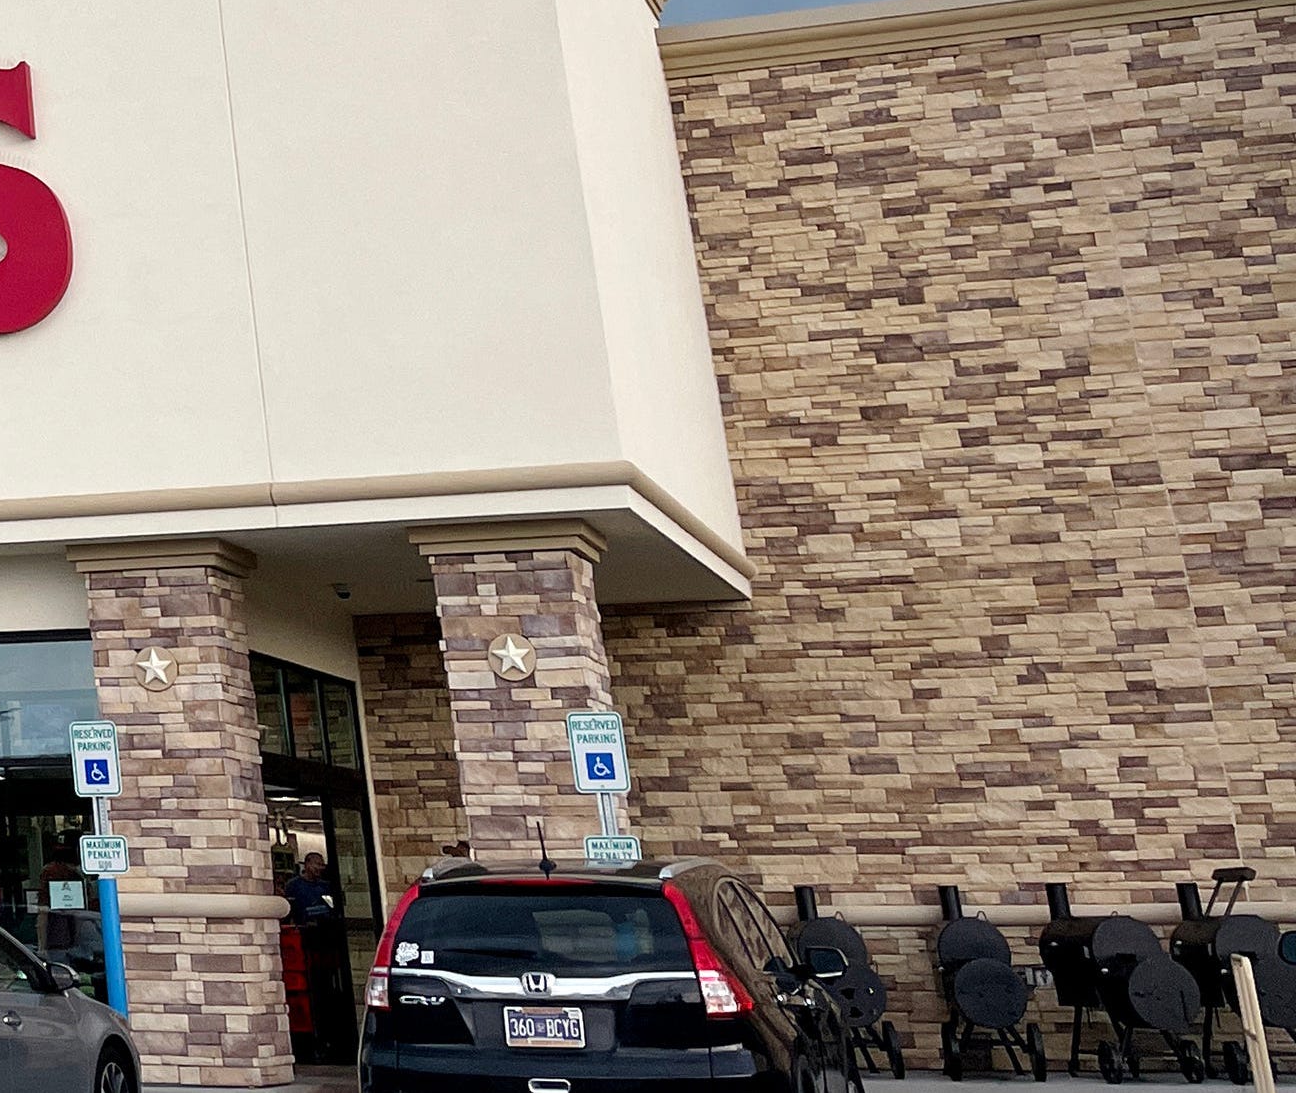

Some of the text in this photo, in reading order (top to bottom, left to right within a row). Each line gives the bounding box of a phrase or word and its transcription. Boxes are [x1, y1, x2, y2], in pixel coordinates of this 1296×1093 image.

[572, 719, 617, 731] RESERVED
[73, 729, 113, 739] RESERVED
[576, 733, 617, 744] PARKING
[77, 741, 112, 752] PARKING
[86, 840, 121, 849] MAXIMUM
[591, 841, 633, 850] MAXIMUM
[87, 850, 121, 859] PENALTY
[509, 1018, 535, 1037] 360
[545, 1018, 579, 1038] BCYG
